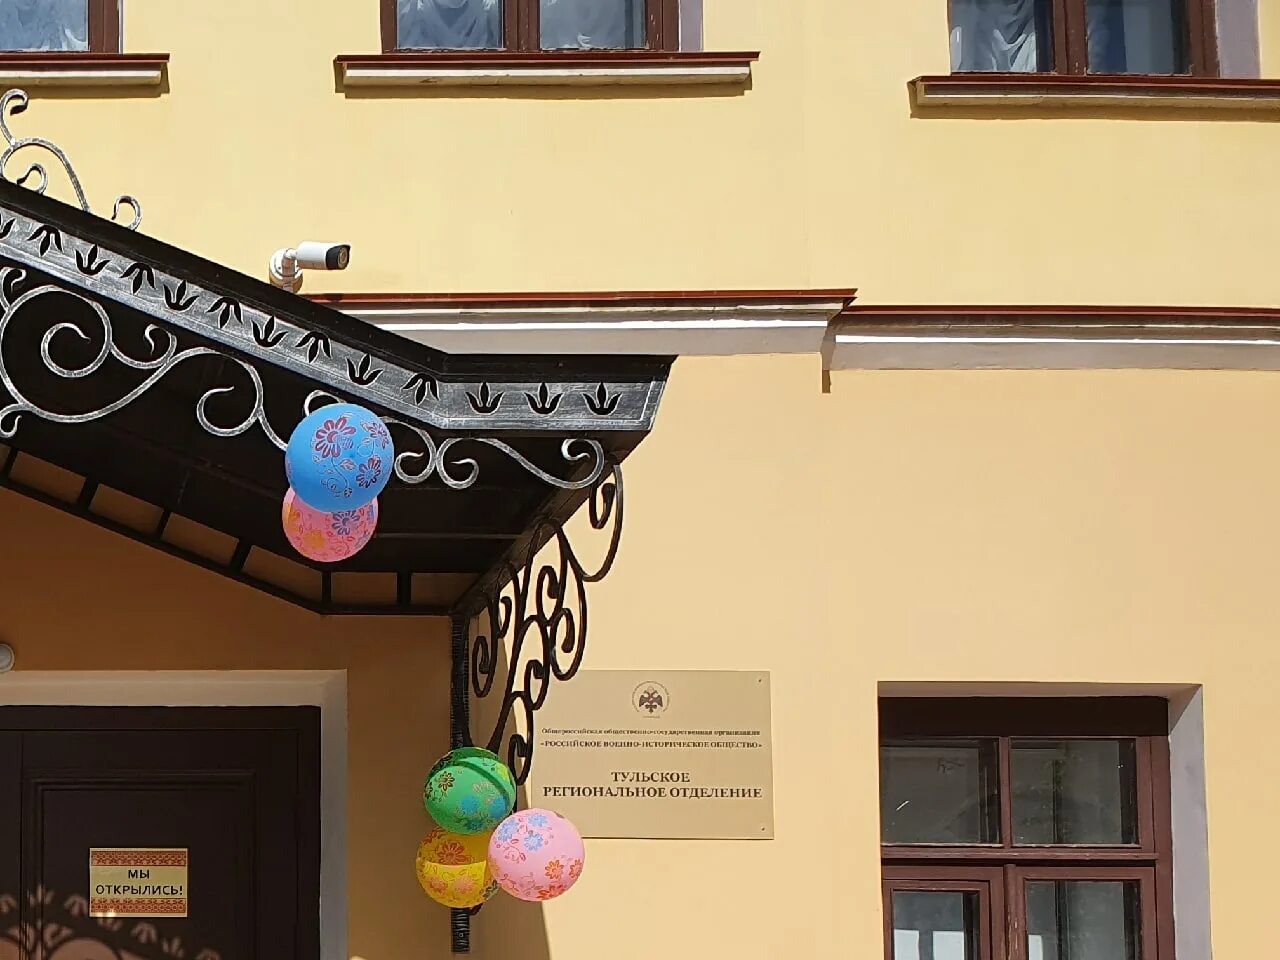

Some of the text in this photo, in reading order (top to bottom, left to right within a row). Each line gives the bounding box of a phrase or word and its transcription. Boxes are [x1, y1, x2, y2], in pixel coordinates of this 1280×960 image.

[603, 740, 709, 748] ВОЕННО-ИСТОРИЧЕСКОЕ
[611, 771, 690, 783] ТУЛЬСКОЕ
[543, 786, 763, 800] РЕГИОНАЛЬНОЕ ОТДЕЛЕНИЕ
[128, 869, 150, 879] МЫ
[95, 884, 183, 896] ОТКРЫЛИСЬ!
